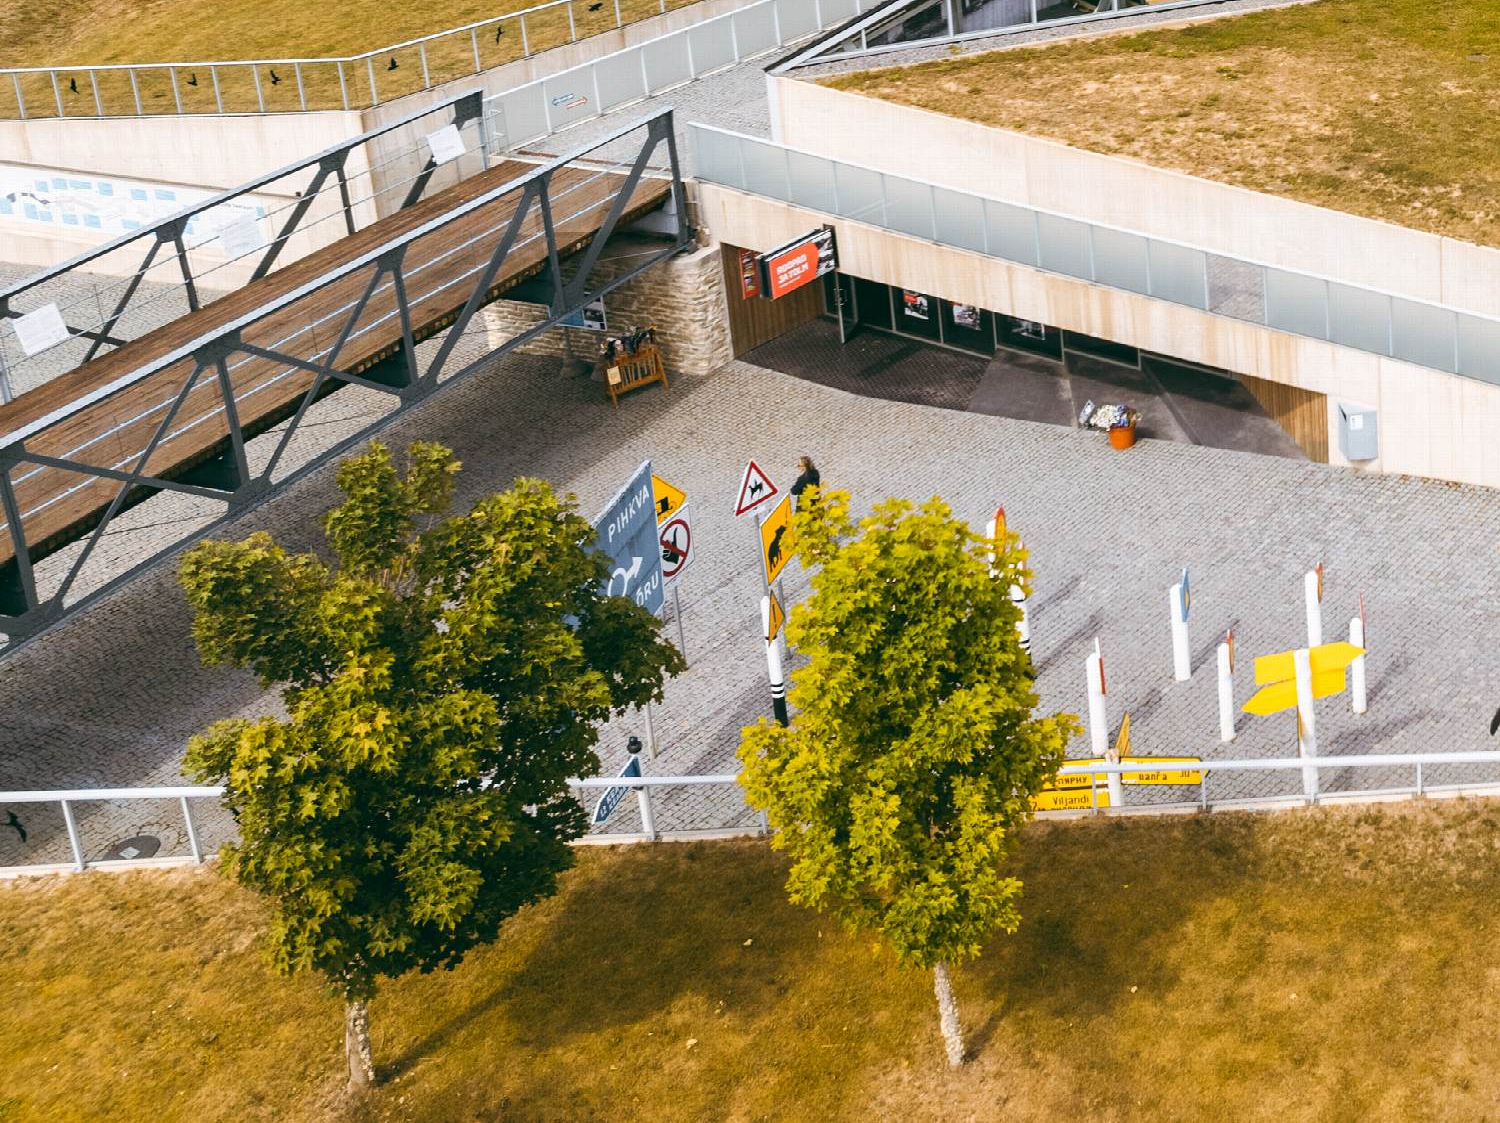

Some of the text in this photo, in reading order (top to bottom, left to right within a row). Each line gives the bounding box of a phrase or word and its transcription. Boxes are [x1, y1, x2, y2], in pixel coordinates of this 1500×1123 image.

[608, 484, 650, 543] PIHKVA
[636, 570, 660, 608] ÕRU
[1053, 795, 1090, 806] Viljandi
